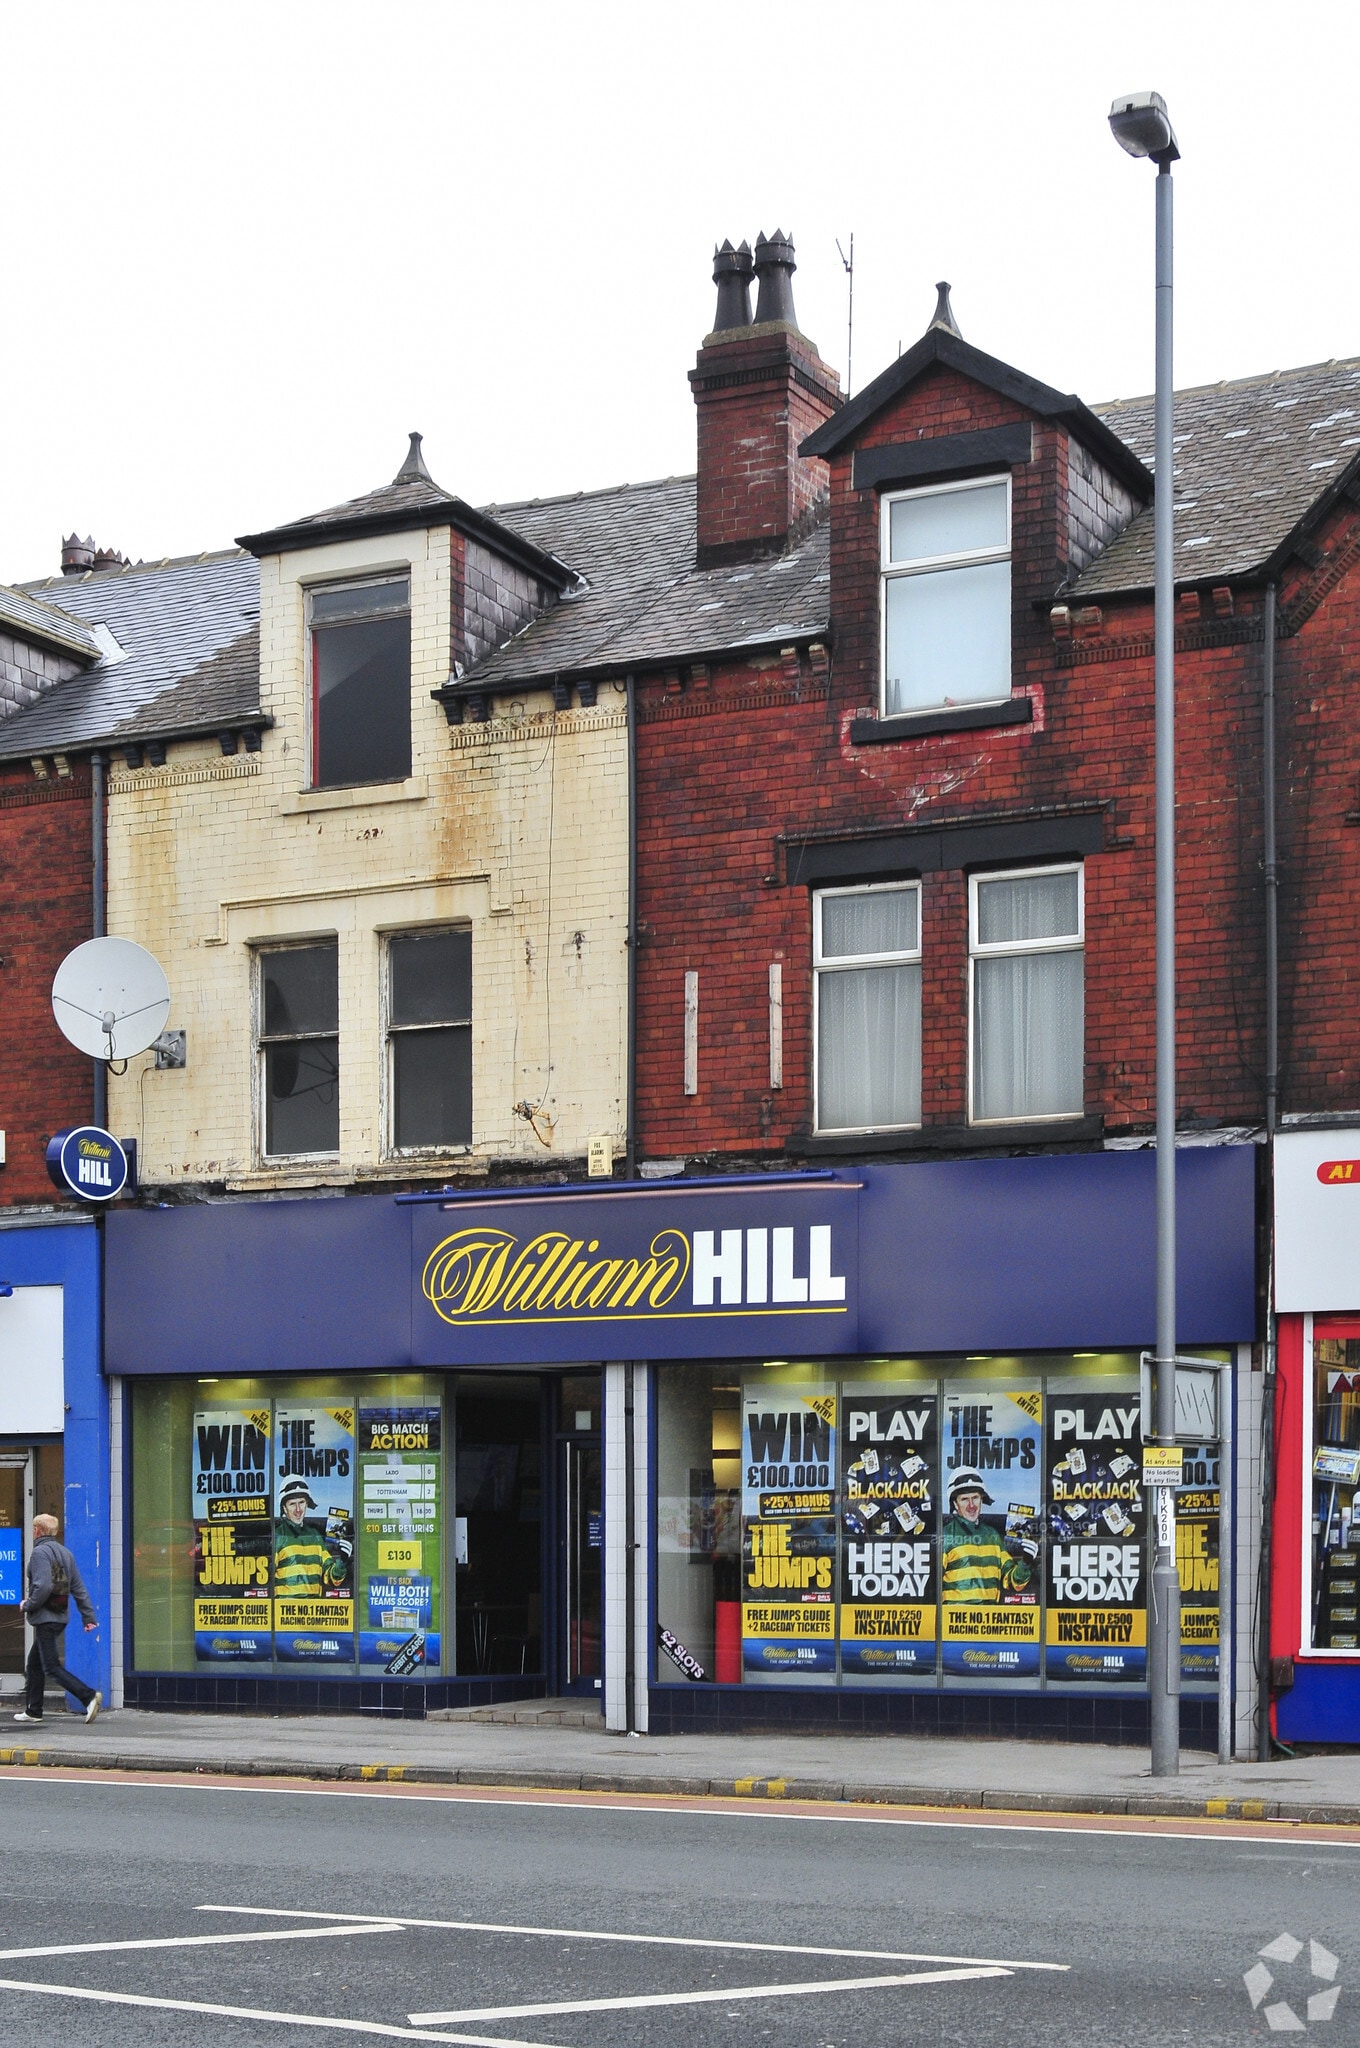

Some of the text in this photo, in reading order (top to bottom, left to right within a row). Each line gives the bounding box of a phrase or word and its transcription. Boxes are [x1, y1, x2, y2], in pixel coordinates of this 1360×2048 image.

[78, 1138, 111, 1158] William
[78, 1158, 112, 1187] HILL
[421, 1225, 846, 1315] William HILL
[824, 1398, 834, 1409] £2
[1016, 1397, 1038, 1416] ENTRY
[1030, 1394, 1040, 1404] £2
[259, 1411, 270, 1421] £2
[343, 1409, 353, 1420] £2
[812, 1401, 833, 1420] ENTRY
[250, 1414, 268, 1432] ENTRY
[333, 1413, 351, 1430] ENTRY
[371, 1423, 428, 1434] BIG MATCH
[849, 1410, 930, 1442] PLAY
[948, 1406, 993, 1438] THE
[1054, 1408, 1140, 1440] PLAY
[279, 1419, 315, 1448] THE
[748, 1412, 830, 1463] WIN
[197, 1424, 265, 1471] WIN
[370, 1434, 429, 1450] ACTION
[947, 1438, 1036, 1470] JUMPS
[279, 1448, 350, 1478] JUMPS
[196, 1472, 266, 1494] £100,000
[747, 1464, 830, 1488] £100,000
[848, 1478, 930, 1500] BLACKJACK
[1052, 1479, 1140, 1502] BLACKJACK
[211, 1498, 266, 1513] +25% BONUS
[764, 1494, 830, 1508] +25% BONUS
[1178, 1494, 1210, 1508] +25%
[366, 1524, 434, 1534] £10 BET RETURNS
[199, 1526, 236, 1556] THE
[748, 1524, 792, 1556] THE
[1176, 1525, 1208, 1558] HE
[387, 1550, 412, 1560] £130
[848, 1542, 930, 1574] HERE
[1052, 1544, 1140, 1578] HERE
[199, 1556, 269, 1585] JUMPS
[748, 1556, 832, 1588] JUMPS
[398, 1577, 412, 1585] BACK
[848, 1574, 930, 1597] TODAY
[371, 1586, 429, 1598] WILL BOTH
[1052, 1578, 1140, 1601] TODAY
[198, 1604, 268, 1615] FREE JUMPS GUIDE
[280, 1604, 349, 1616] THE NO.1 FANTASY
[397, 1598, 429, 1606] SCORE?
[198, 1616, 268, 1626] +2 RACEDAY TICKETS
[280, 1616, 349, 1626] RACING COMPETITION
[747, 1610, 830, 1621] FREE JUMPS GUIDE
[854, 1610, 922, 1620] WIN UP TO £250
[948, 1612, 1034, 1624] THE NO.1 FANTASY
[1058, 1612, 1132, 1624] WIN UP TO £500
[1184, 1614, 1219, 1626] JUMPS
[747, 1622, 830, 1632] +2 RACEDAY TICKETS
[854, 1620, 922, 1636] INSTANTLY
[948, 1626, 1034, 1636] RACING COMPETITION
[1058, 1624, 1132, 1642] INSTANTLY
[1180, 1628, 1213, 1638] ACEDAY
[212, 1638, 256, 1650] William HILL
[292, 1638, 339, 1650] William HILL
[390, 1654, 408, 1674] DEBIT
[406, 1633, 424, 1656] CARD
[660, 1630, 704, 1678] £2 SLOTS
[662, 1644, 680, 1665] AVAILABLE
[762, 1646, 817, 1659] William HILL
[860, 1648, 916, 1660] William HILL
[962, 1650, 1020, 1664] William HILL
[1065, 1654, 1124, 1668] William HILL
